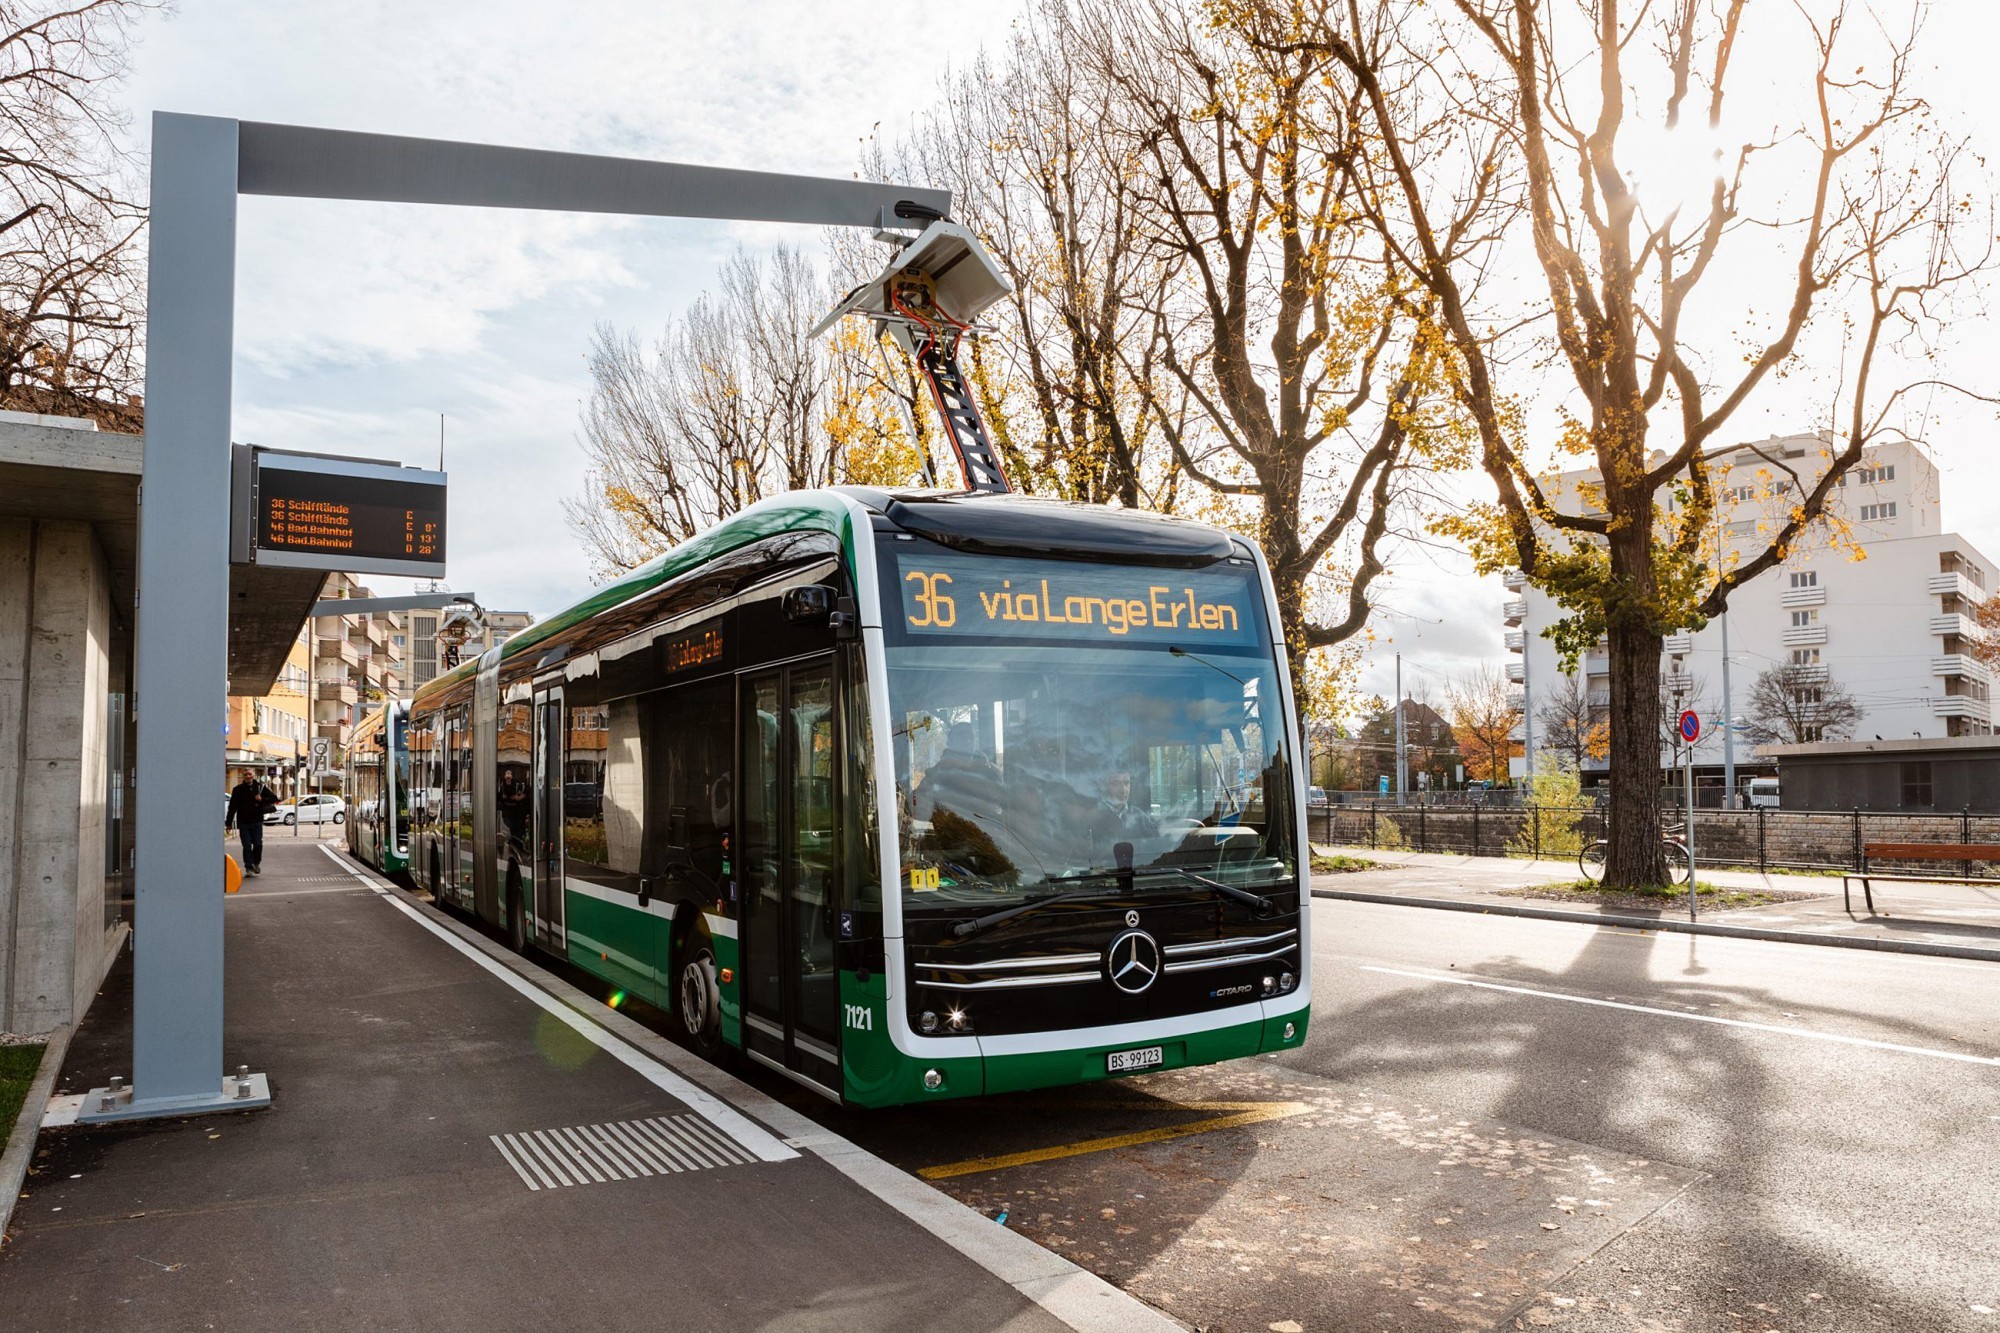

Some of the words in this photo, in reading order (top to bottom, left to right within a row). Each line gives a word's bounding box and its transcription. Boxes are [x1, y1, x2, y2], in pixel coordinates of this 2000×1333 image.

[271, 499, 285, 509] 36
[406, 511, 413, 519] E
[271, 511, 285, 520] 36
[406, 522, 413, 531] E
[271, 522, 285, 532] 46
[287, 523, 353, 537] Bad.Bahnhof
[270, 534, 284, 543] 46
[287, 535, 353, 548] Bad.Bahnhof
[905, 571, 957, 628] 36
[844, 1003, 872, 1031] 7121
